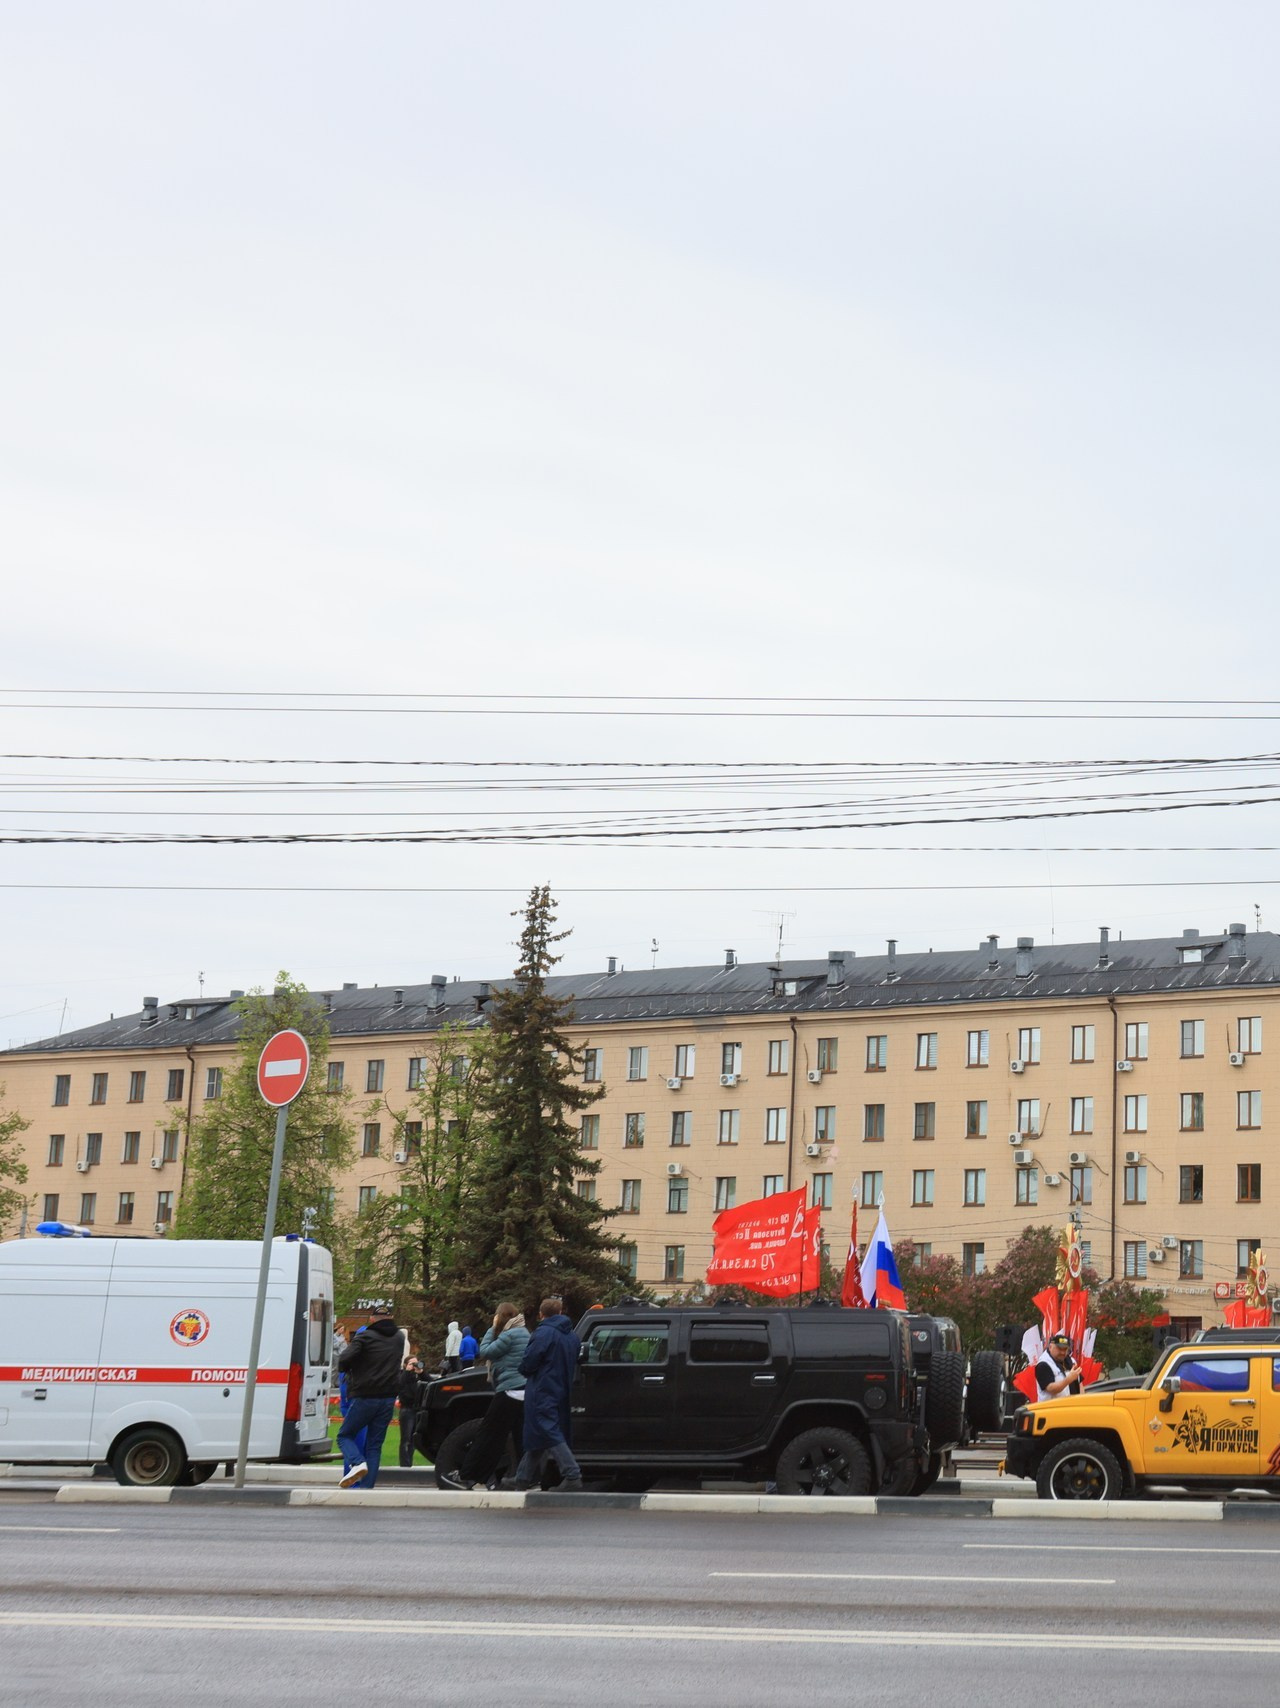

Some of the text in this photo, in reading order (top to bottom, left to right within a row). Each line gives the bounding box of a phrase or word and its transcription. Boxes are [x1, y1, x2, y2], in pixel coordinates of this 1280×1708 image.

[21, 1368, 257, 1383] МЕДИЦИНСКАЯ ПОМОЩ
[1200, 1427, 1253, 1452] Я ПОМНЮ
